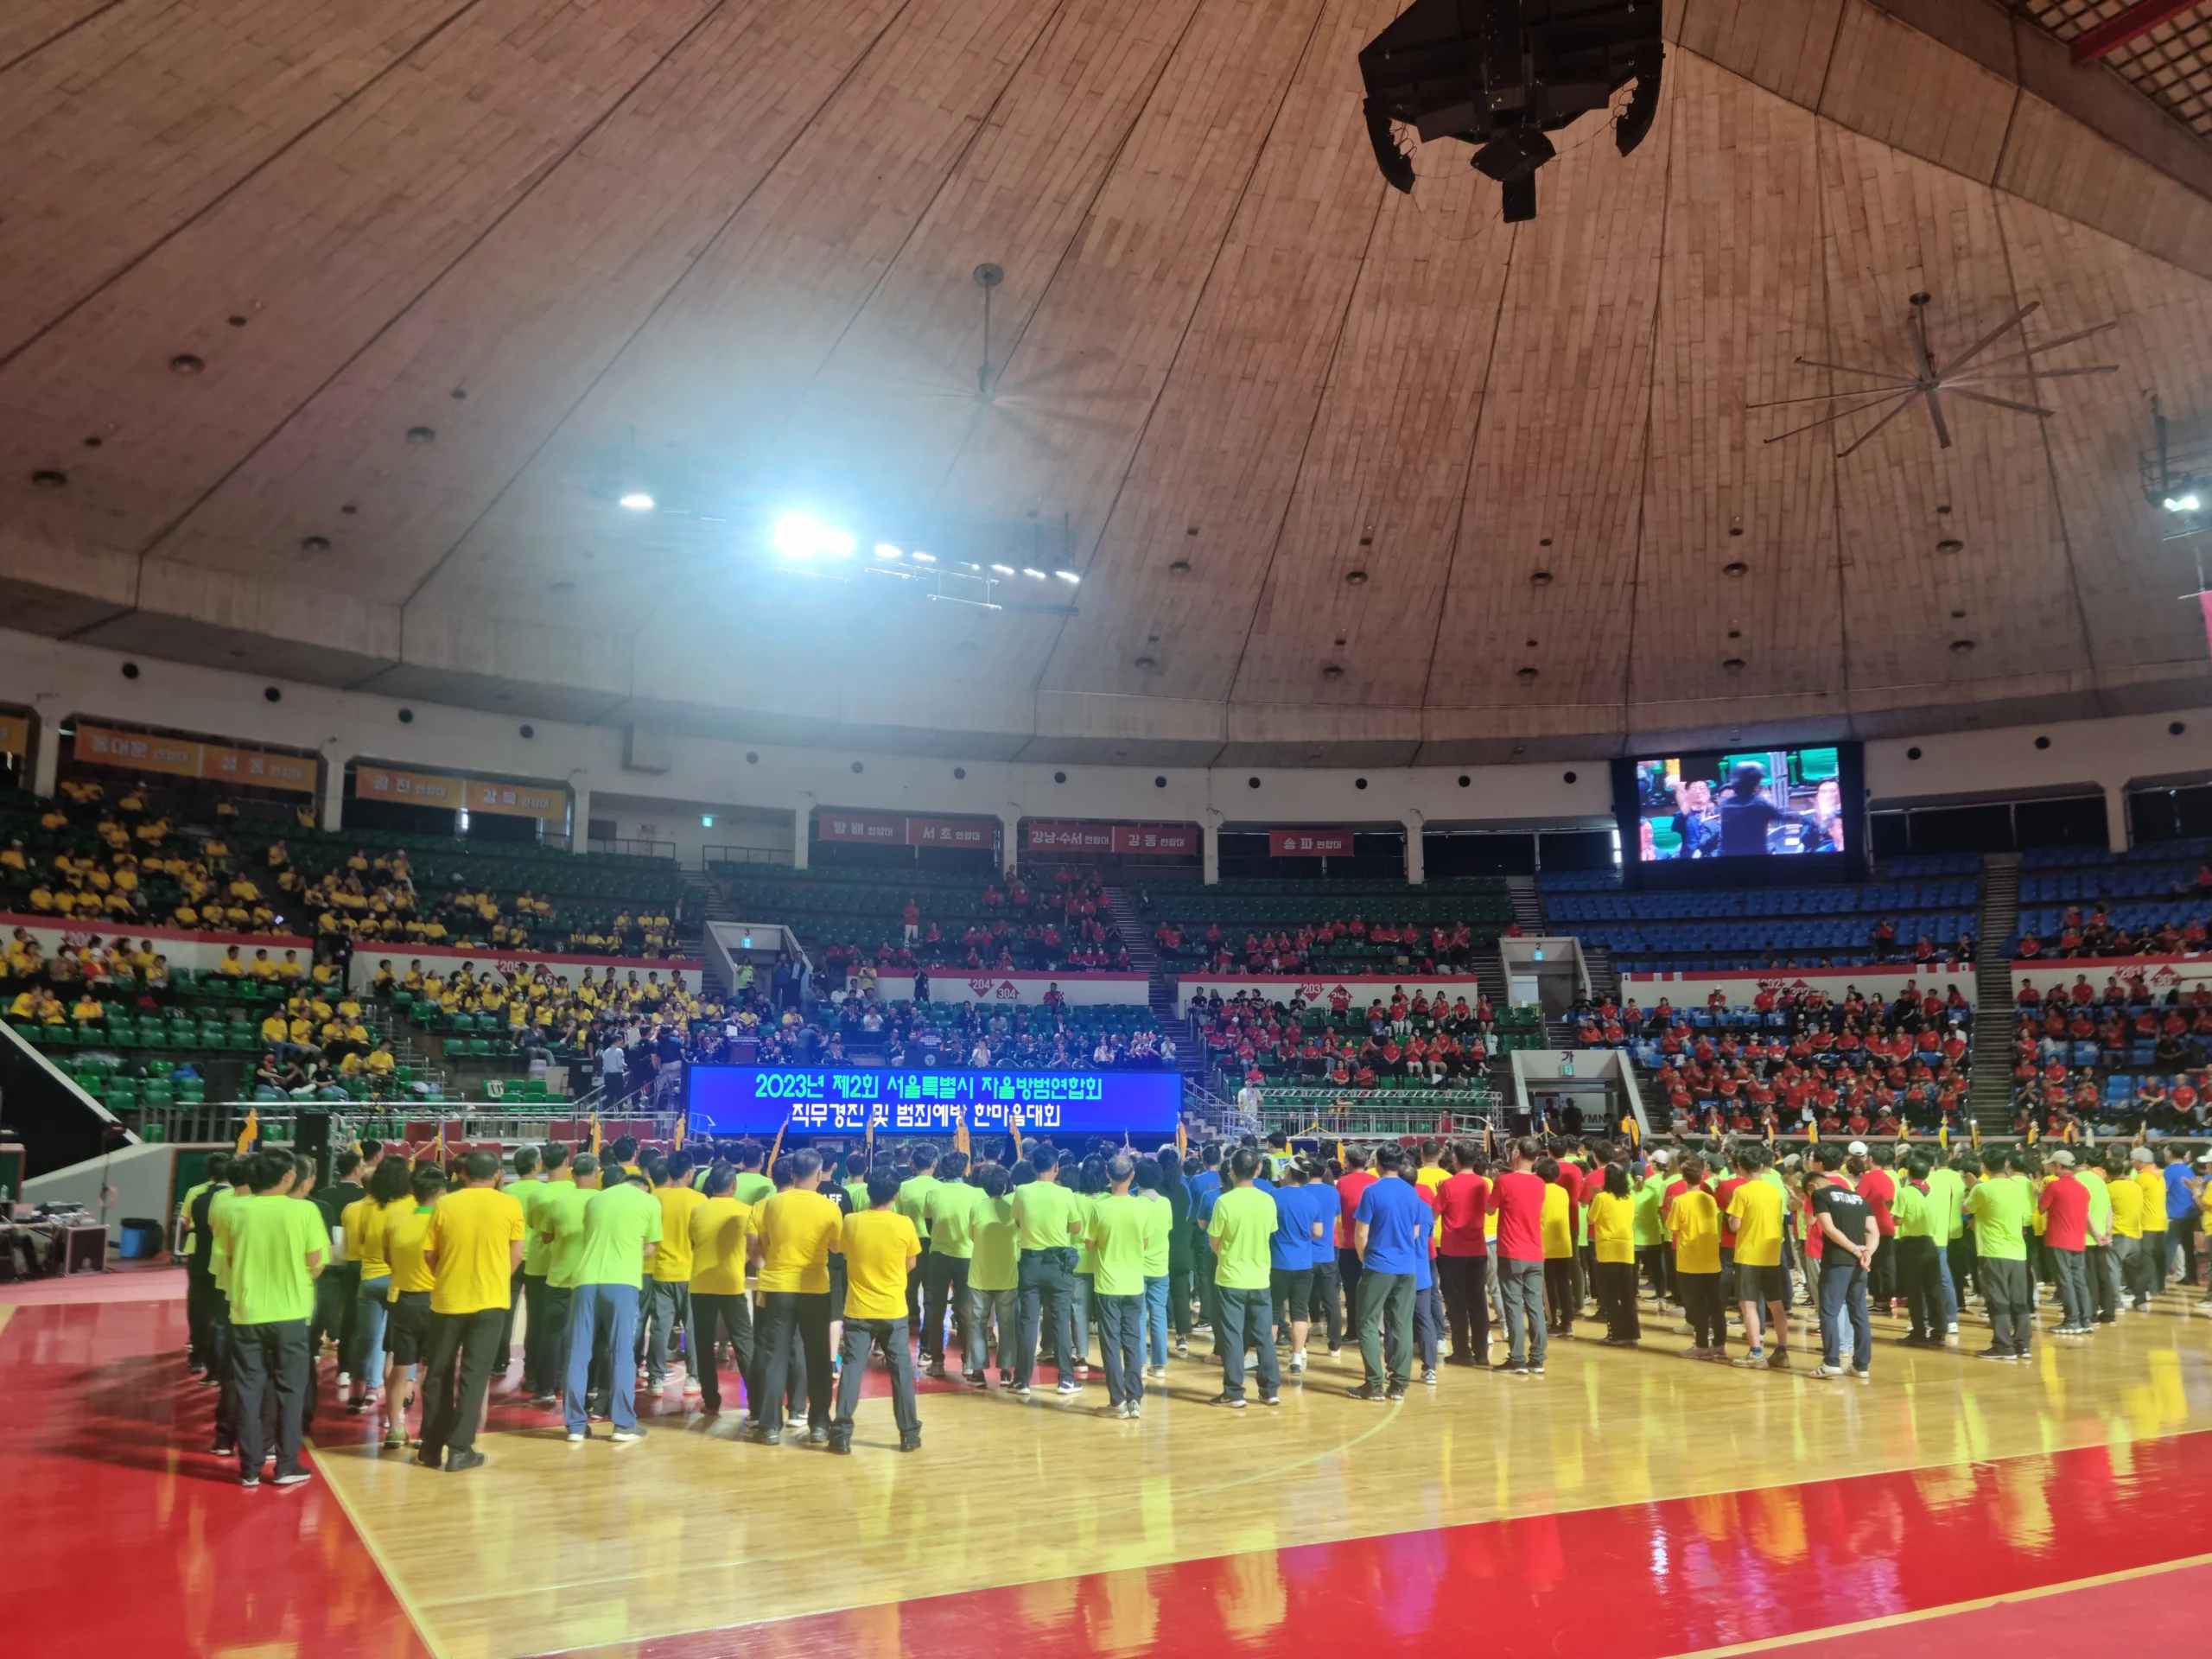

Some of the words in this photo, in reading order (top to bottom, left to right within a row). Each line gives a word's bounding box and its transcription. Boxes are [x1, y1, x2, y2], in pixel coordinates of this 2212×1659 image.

[956, 830, 981, 841] 연합대
[1084, 836, 1109, 845] 연합대
[1160, 838, 1185, 847] 연합대
[1316, 840, 1342, 849] 연합대
[972, 979, 990, 989] 204
[1303, 983, 1320, 994] 203
[998, 988, 1016, 998] 304
[1561, 1051, 1574, 1064] 가
[755, 1073, 823, 1098] 2023년
[833, 1074, 879, 1098] 제2회
[887, 1075, 974, 1100] 서울특별시
[982, 1076, 1102, 1100] 자율방범연합회
[791, 1103, 863, 1128] 직무경진
[873, 1103, 889, 1128] 및
[897, 1103, 967, 1128] 범죄예방
[975, 1103, 1060, 1128] 한마음대회
